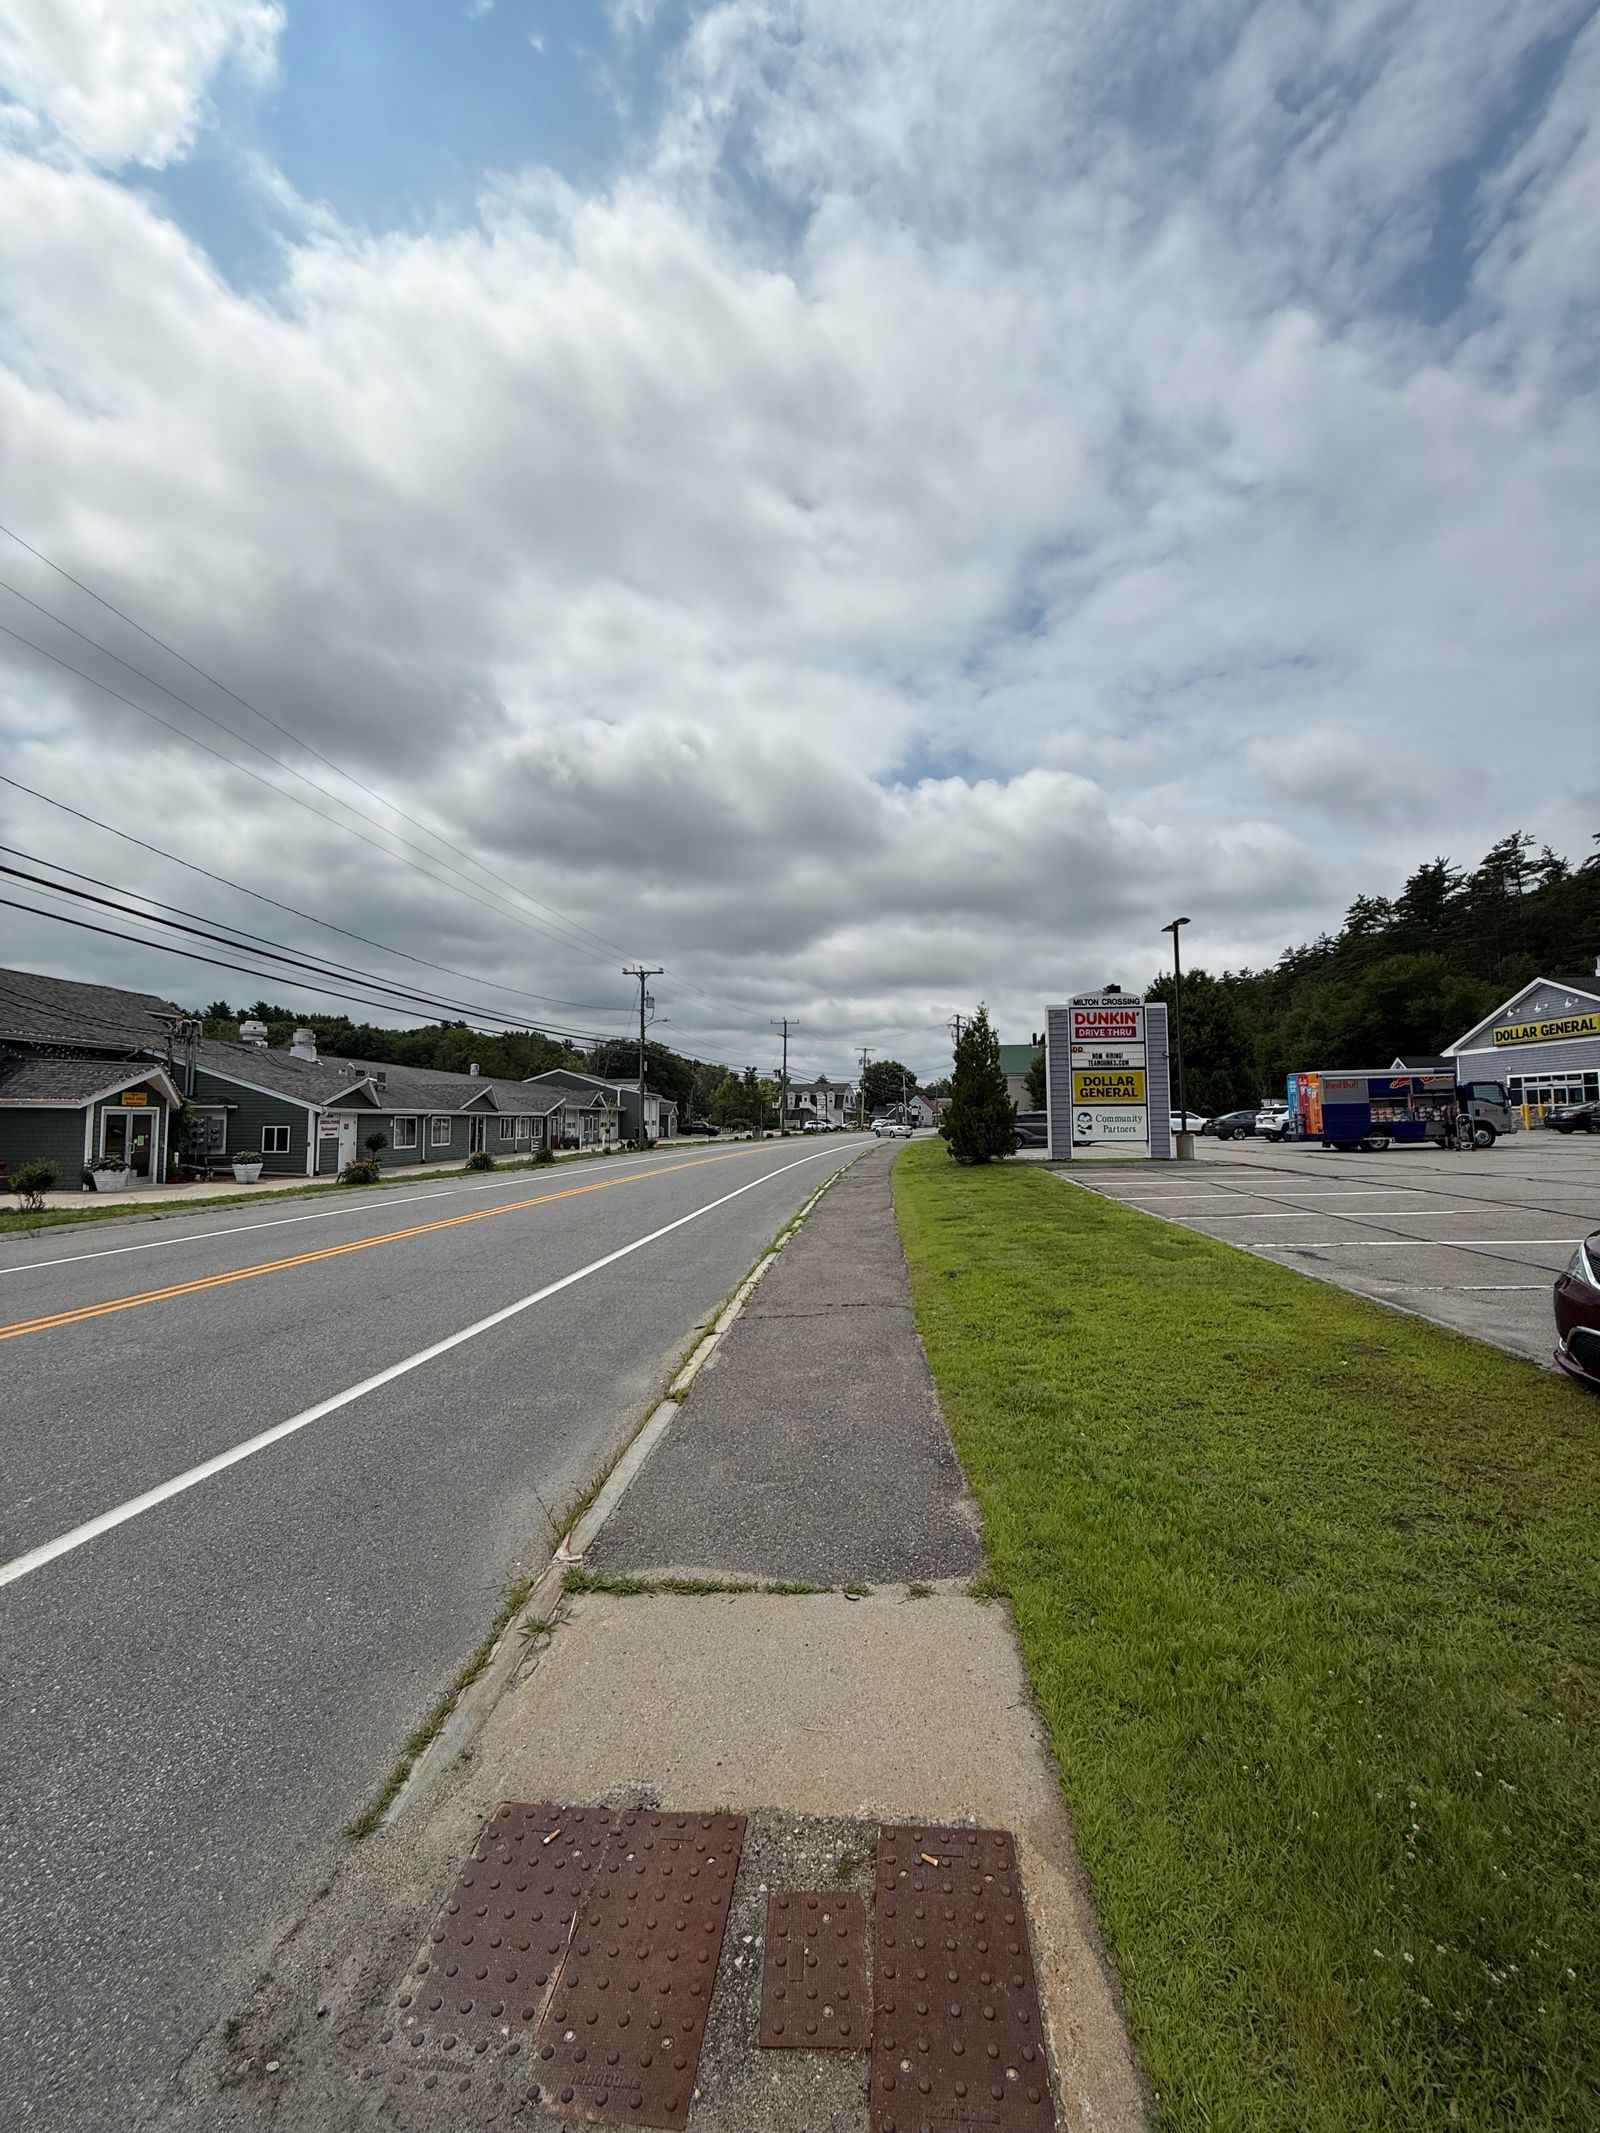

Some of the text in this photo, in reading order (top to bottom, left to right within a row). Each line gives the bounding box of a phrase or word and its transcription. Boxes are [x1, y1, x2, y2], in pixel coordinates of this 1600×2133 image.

[1102, 998, 1140, 1006] CROSSING
[1074, 1011, 1140, 1025] DUNKIN'
[1079, 1028, 1132, 1037] DRIVE THRU
[1495, 1017, 1597, 1042] DOLLAR GENERAL
[1083, 1076, 1134, 1086] DOLLAR
[1325, 1079, 1341, 1089] Red
[1343, 1079, 1359, 1089] Bull
[1080, 1088, 1138, 1098] GENERAL
[1095, 1114, 1142, 1124] Community
[1103, 1125, 1137, 1133] Partners
